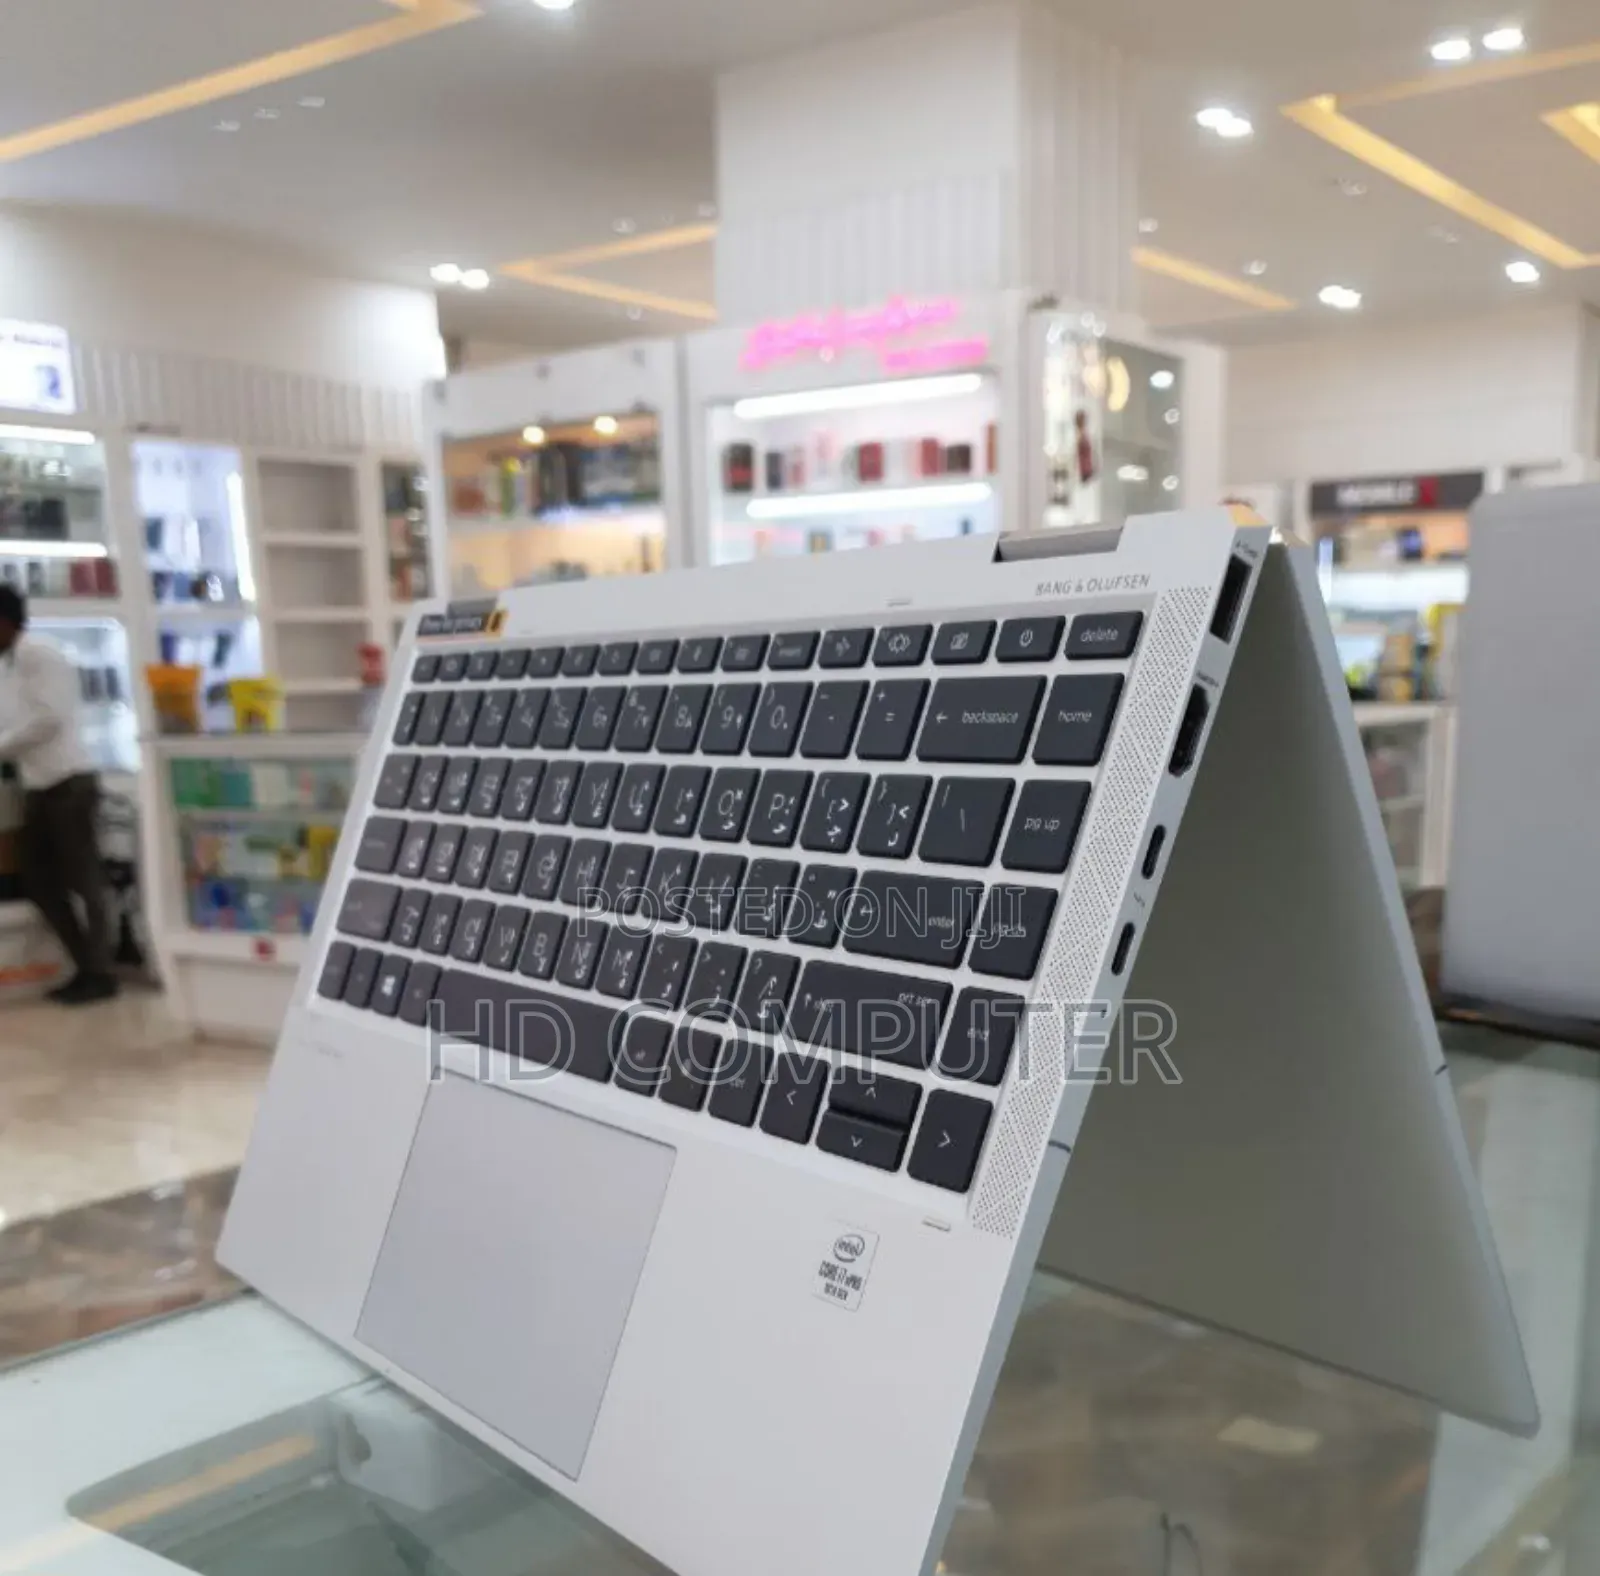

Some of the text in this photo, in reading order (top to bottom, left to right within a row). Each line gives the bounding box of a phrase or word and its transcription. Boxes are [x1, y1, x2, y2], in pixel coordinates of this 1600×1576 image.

[1035, 574, 1151, 596] BANG & OLUFSEN
[1080, 626, 1119, 643] delete
[721, 704, 735, 729] 9
[961, 710, 1020, 725] backspace
[1057, 708, 1093, 724] home
[768, 793, 785, 820] P
[1024, 817, 1061, 831] pg up
[928, 915, 955, 928] enter
[833, 1239, 864, 1258] intel
[818, 1259, 840, 1282] CORE
